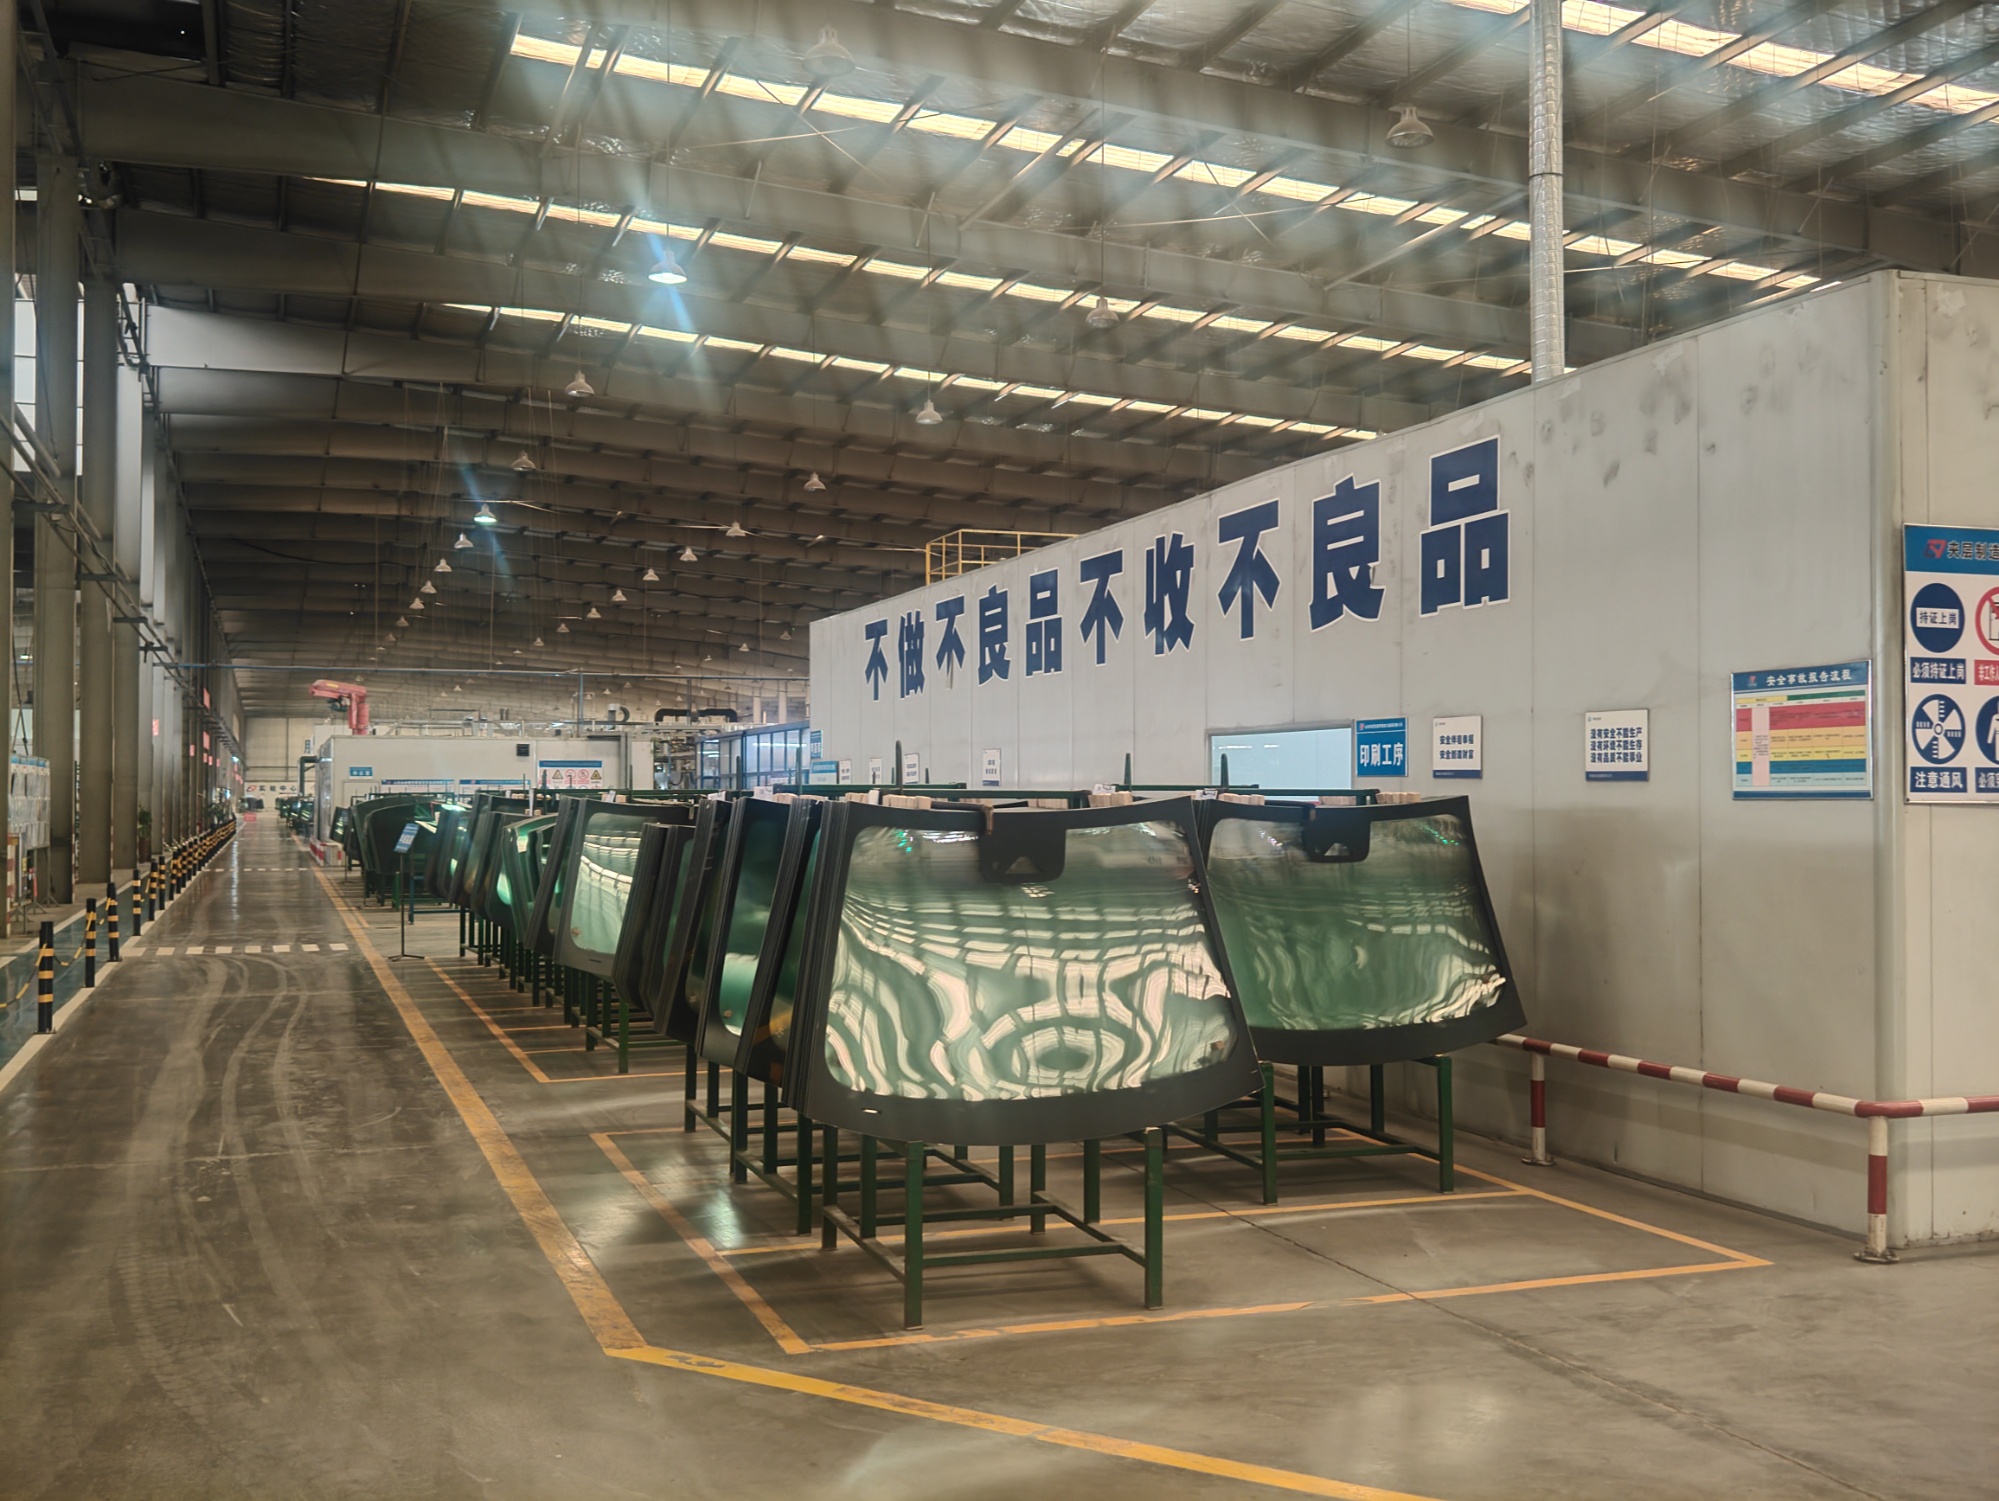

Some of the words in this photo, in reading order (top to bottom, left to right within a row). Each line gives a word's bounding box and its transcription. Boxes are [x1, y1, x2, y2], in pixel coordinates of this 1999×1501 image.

[1919, 611, 1957, 625] 持证上岗
[1766, 669, 1852, 686] 安全事故报告流程
[1912, 661, 1965, 680] 必须持证上岗
[1590, 727, 1642, 739] 没有安全不能生产
[1360, 742, 1403, 767] 印刷工序
[1915, 771, 1963, 789] 注意通风
